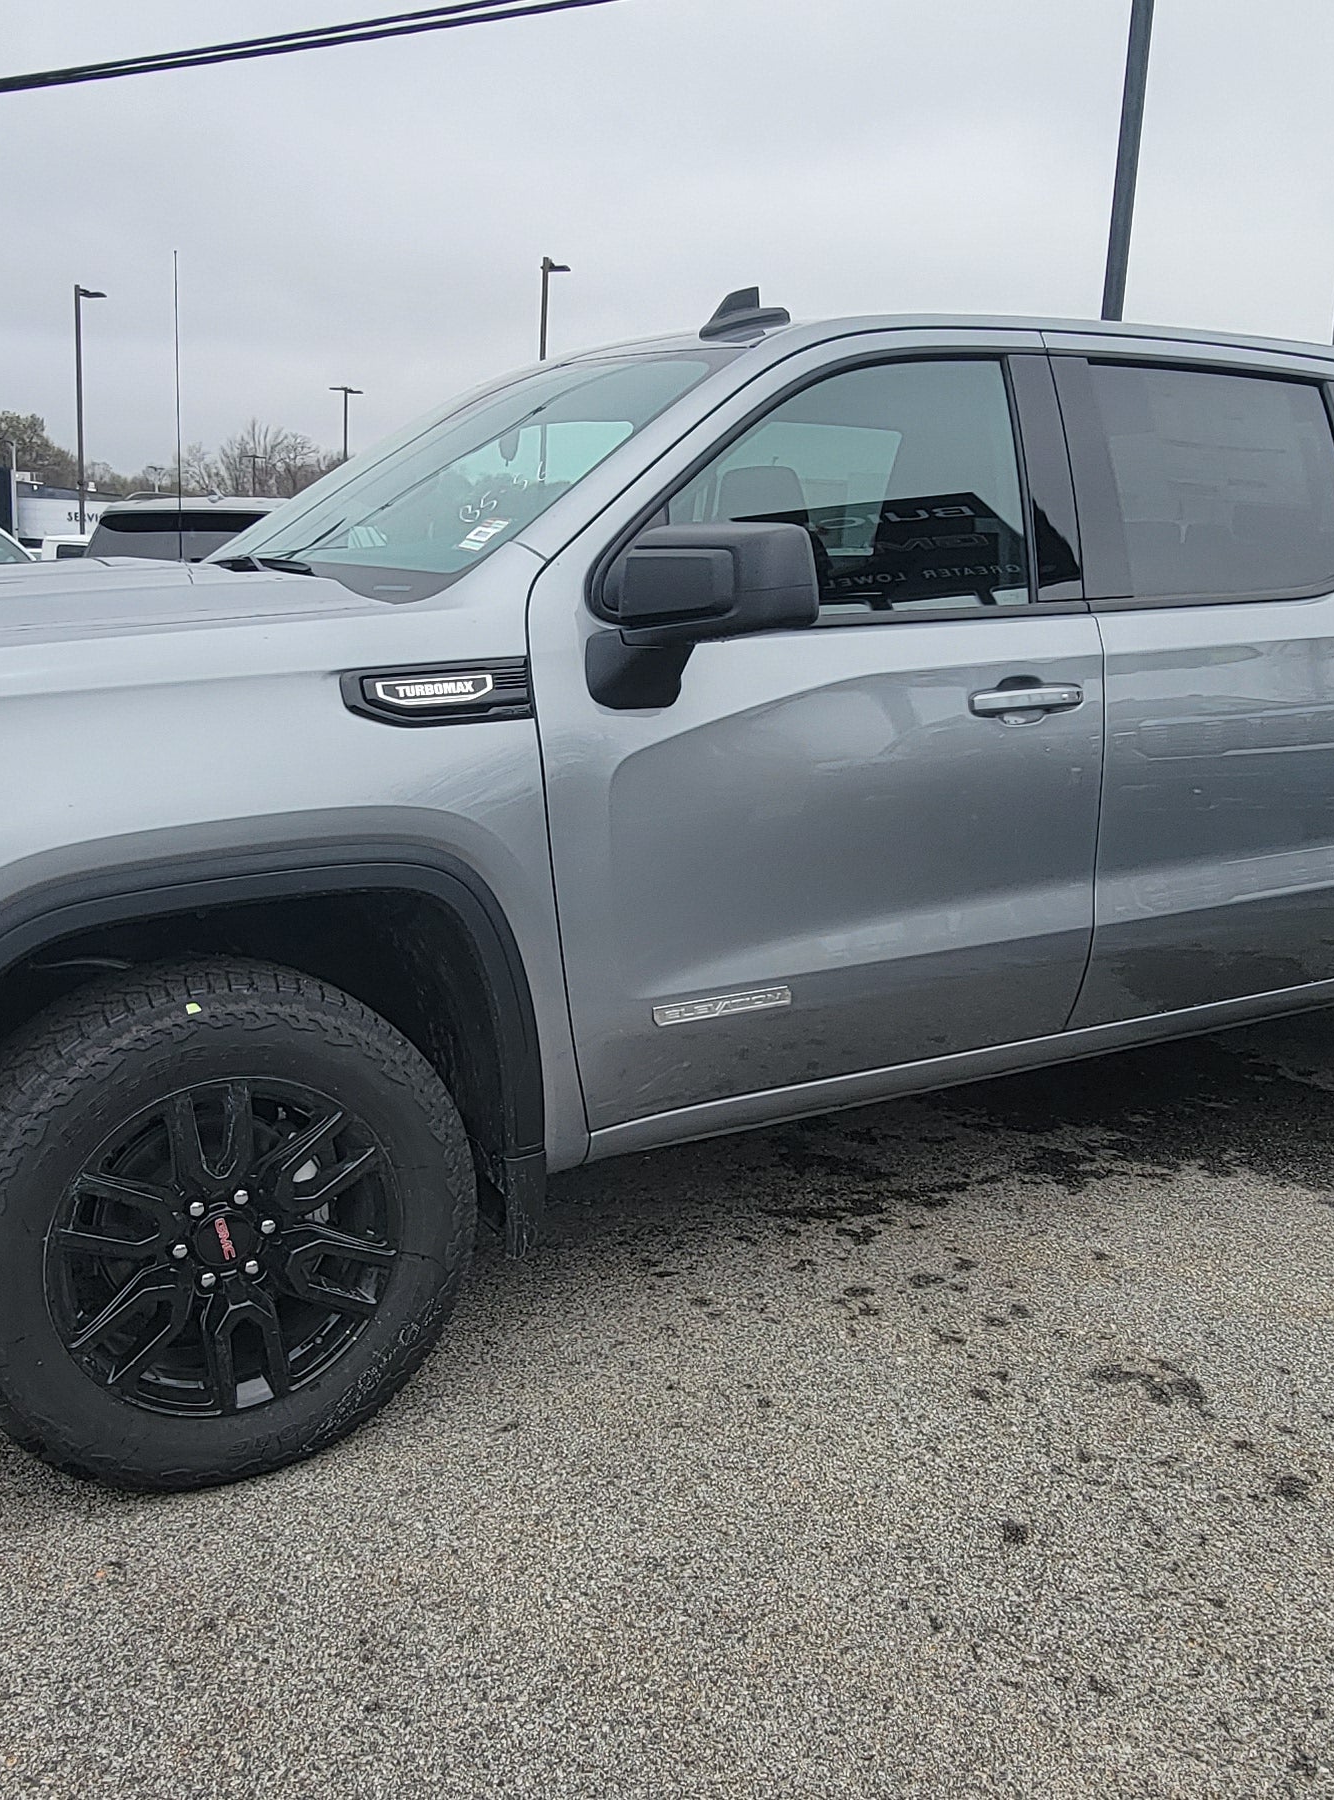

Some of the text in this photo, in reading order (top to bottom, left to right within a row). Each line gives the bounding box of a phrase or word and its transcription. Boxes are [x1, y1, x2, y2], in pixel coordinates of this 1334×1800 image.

[395, 680, 475, 698] TURBOMAX
[665, 992, 782, 1019] ELEVATION
[214, 1218, 236, 1260] GMC
